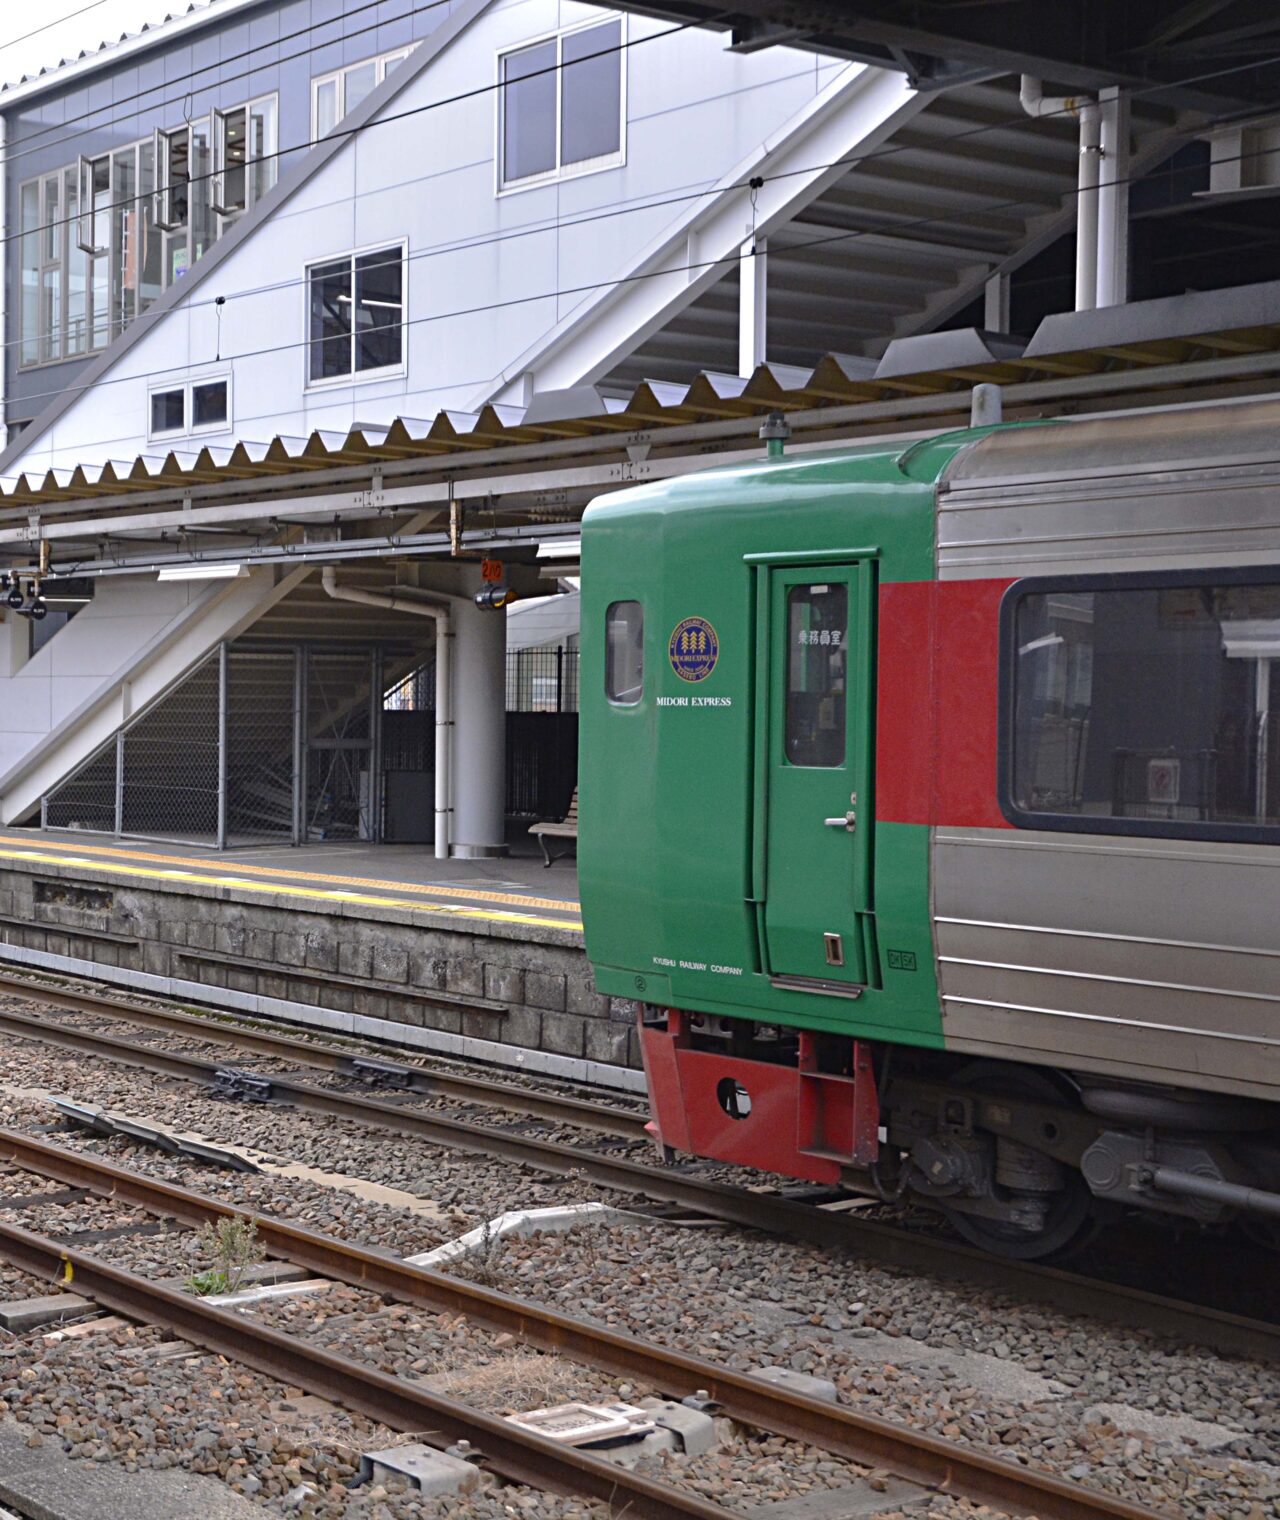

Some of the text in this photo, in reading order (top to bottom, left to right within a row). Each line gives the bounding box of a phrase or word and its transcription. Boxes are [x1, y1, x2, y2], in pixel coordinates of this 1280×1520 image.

[798, 630, 841, 646] 乗務員室
[656, 696, 732, 707] MIDORI EXPRESS
[653, 957, 743, 976] KYUSHU RAILWAY COMPANY
